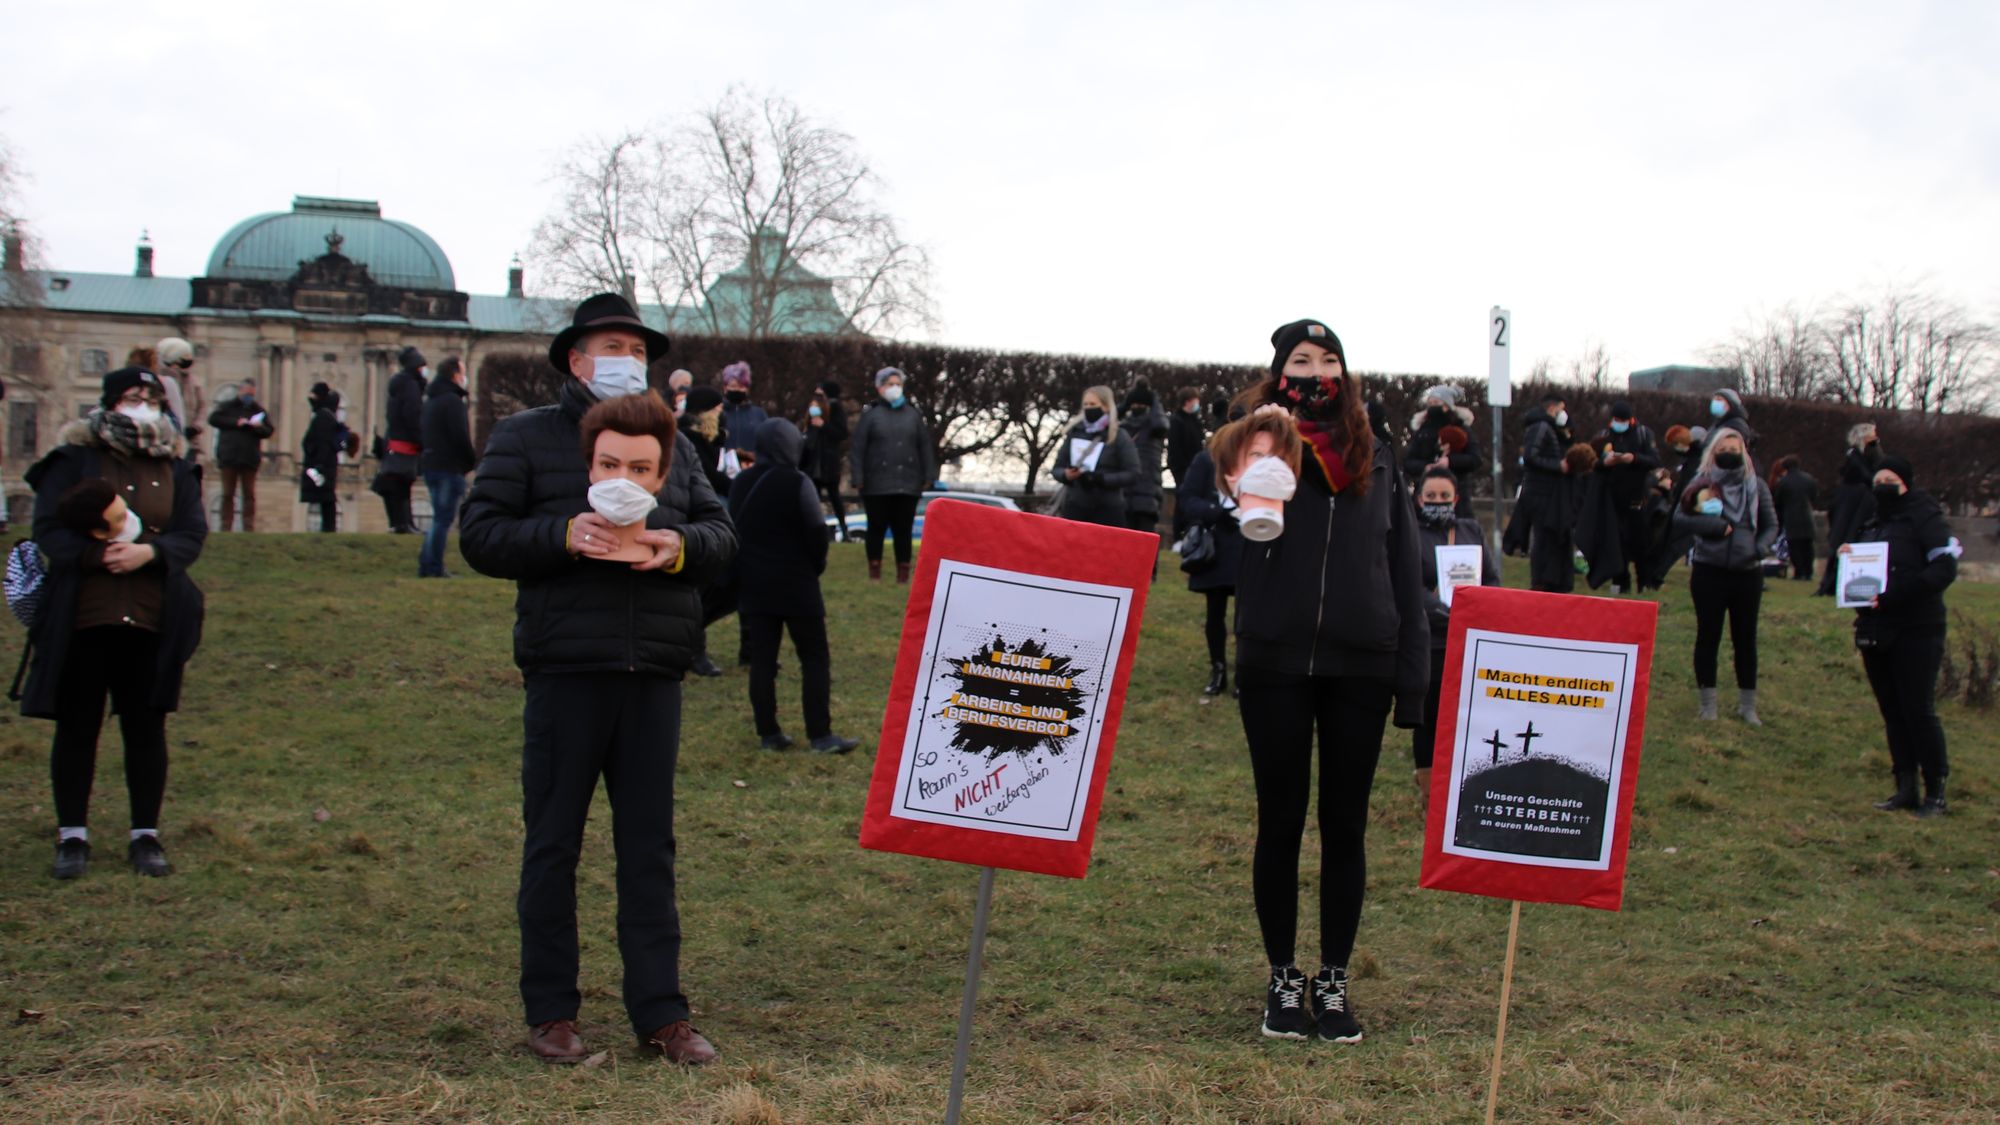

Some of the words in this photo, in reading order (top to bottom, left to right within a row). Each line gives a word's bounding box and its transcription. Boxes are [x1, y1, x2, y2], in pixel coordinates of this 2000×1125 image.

[1494, 316, 1506, 347] 2
[1000, 652, 1042, 669] EURE
[1485, 668, 1541, 686] Macht
[1546, 678, 1610, 692] endlich
[957, 693, 1028, 715] ARBEITS-
[1031, 705, 1064, 720] UND
[1493, 687, 1550, 704] ALLES
[1556, 693, 1599, 708] AUF!
[948, 706, 1068, 735] BERUFSVERBOT
[954, 764, 1008, 812] NICHT
[1485, 790, 1524, 803] Unsere
[1527, 795, 1583, 808] Geschäfte
[1495, 821, 1521, 830] euren
[1524, 823, 1581, 835] Maßnahmen
